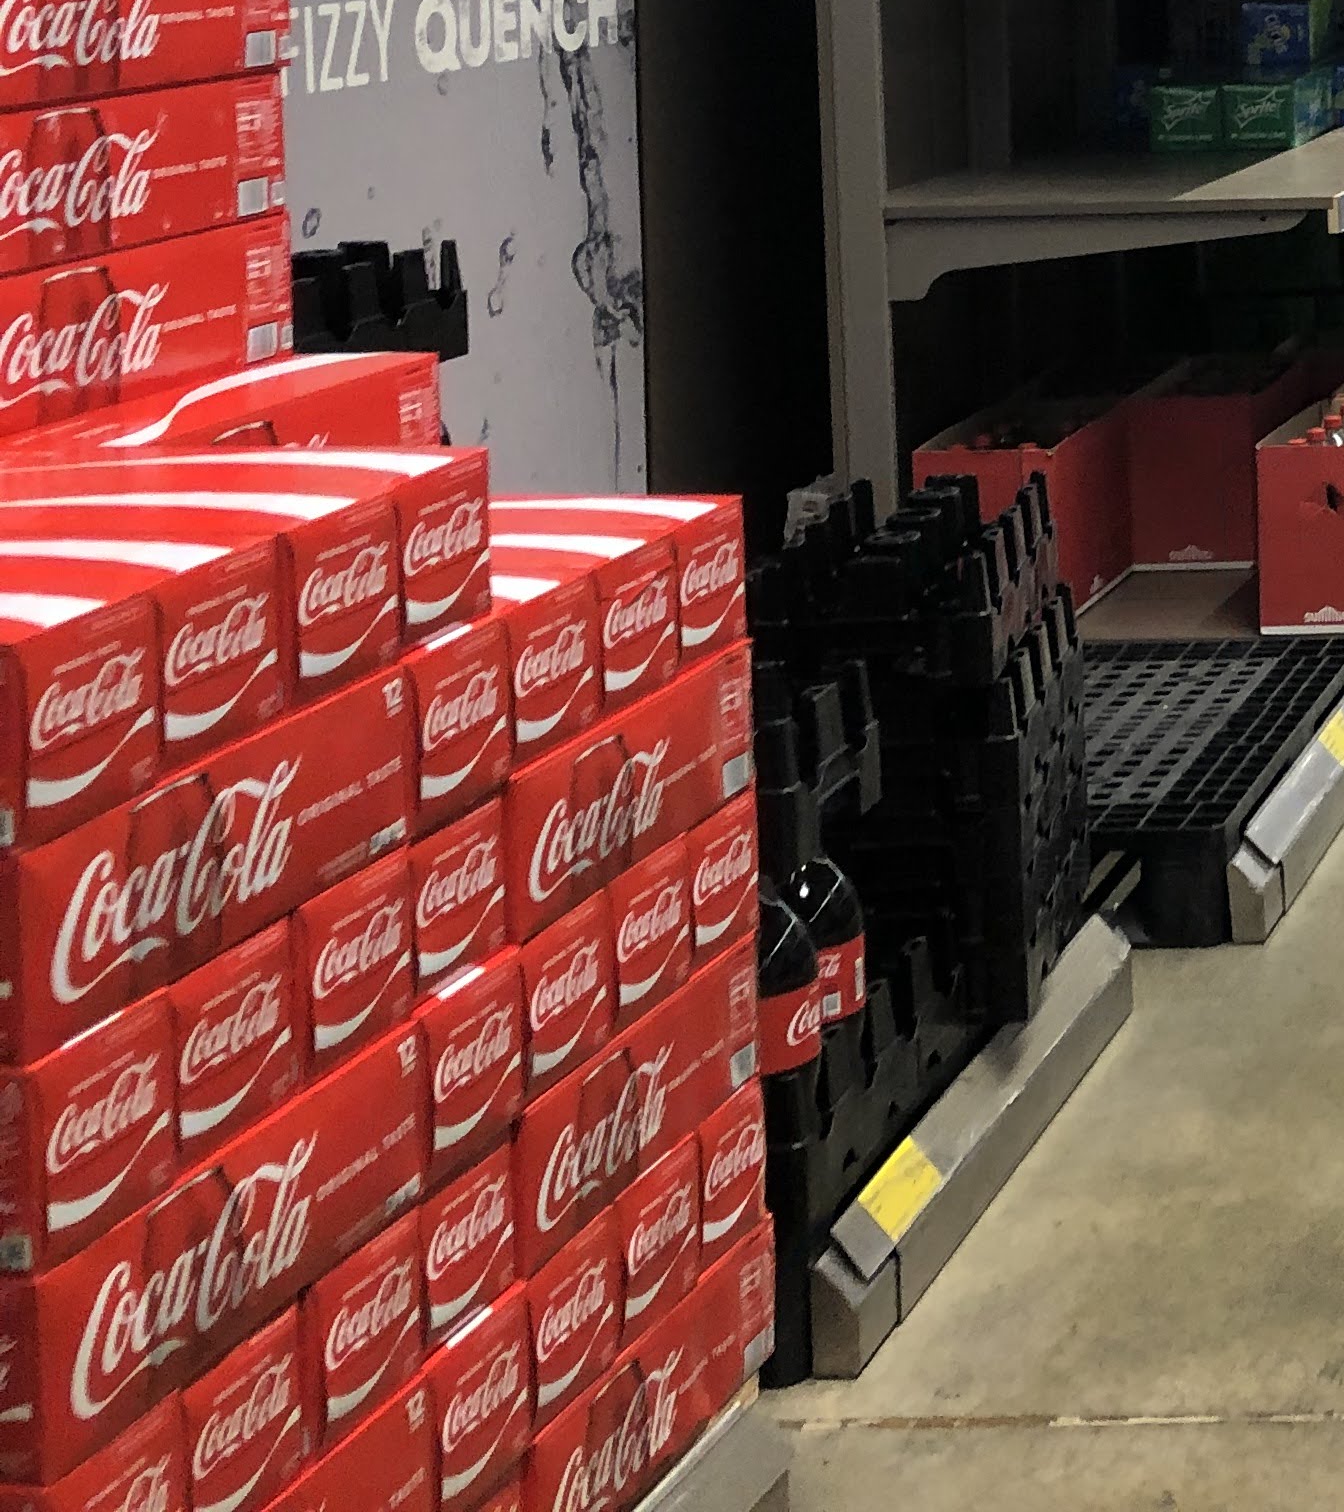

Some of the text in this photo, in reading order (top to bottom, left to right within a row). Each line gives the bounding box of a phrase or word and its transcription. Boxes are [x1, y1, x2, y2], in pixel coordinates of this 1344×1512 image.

[51, 752, 302, 1003] Coca-Cola
[528, 737, 672, 903] Coca-Cola
[538, 1042, 675, 1233] Coca-Cola
[72, 1130, 319, 1420] Coca-Cola
